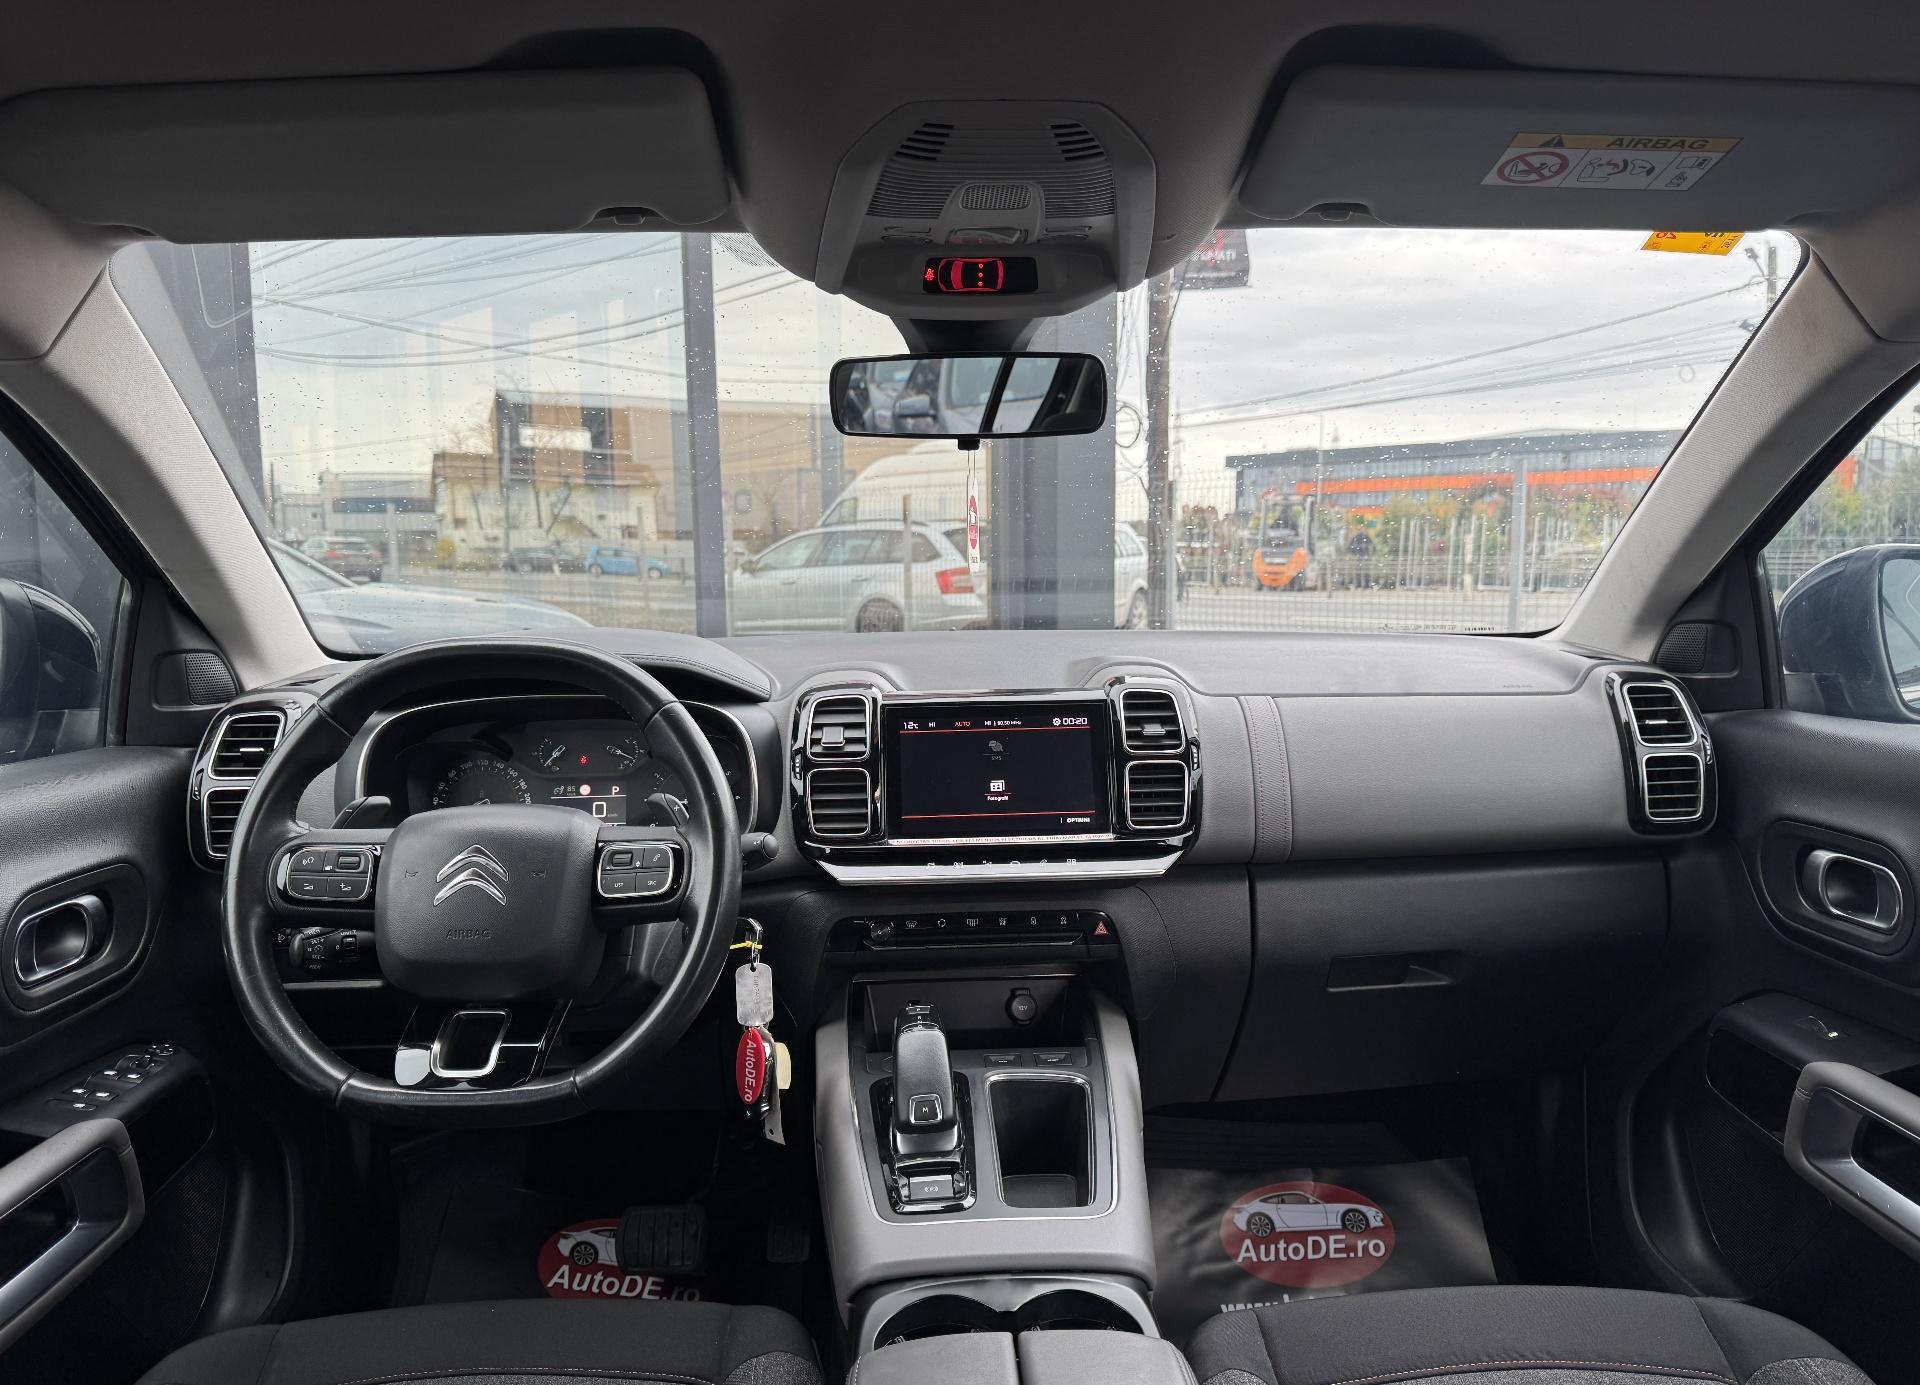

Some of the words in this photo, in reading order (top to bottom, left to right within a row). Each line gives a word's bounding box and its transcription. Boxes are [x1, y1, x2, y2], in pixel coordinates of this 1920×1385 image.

[1605, 137, 1711, 150] AIRBAG
[1062, 717, 1088, 725] 00:20
[507, 767, 518, 777] 160
[519, 778, 528, 790] 180
[611, 785, 620, 796] P
[524, 792, 532, 805] 200
[592, 801, 607, 818] 0
[446, 929, 492, 940] AIRBAG
[744, 1039, 757, 1102] AutoDE.ro
[1237, 1234, 1387, 1264] AutoDE.ro
[547, 1264, 700, 1301] AutoDE.ro
